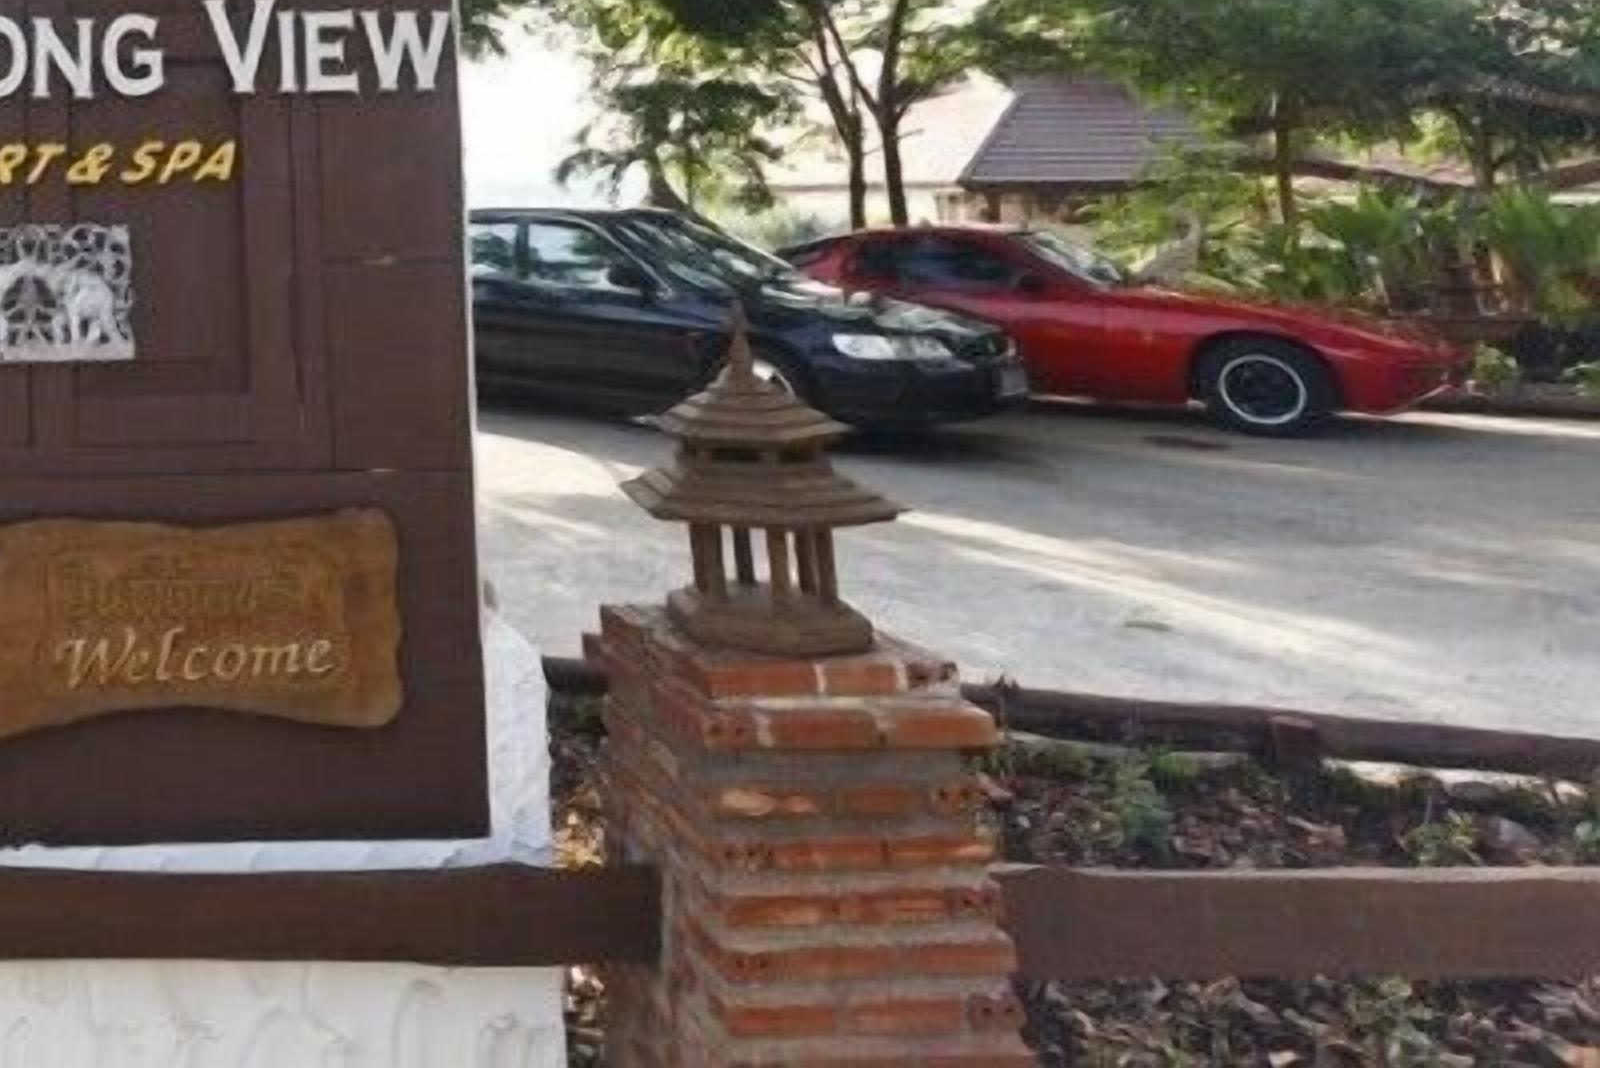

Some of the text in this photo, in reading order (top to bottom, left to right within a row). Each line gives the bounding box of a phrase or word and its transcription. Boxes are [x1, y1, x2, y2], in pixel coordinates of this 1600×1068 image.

[67, 144, 112, 184] &
[121, 139, 236, 183] SPA
[56, 626, 336, 688] Welcome
